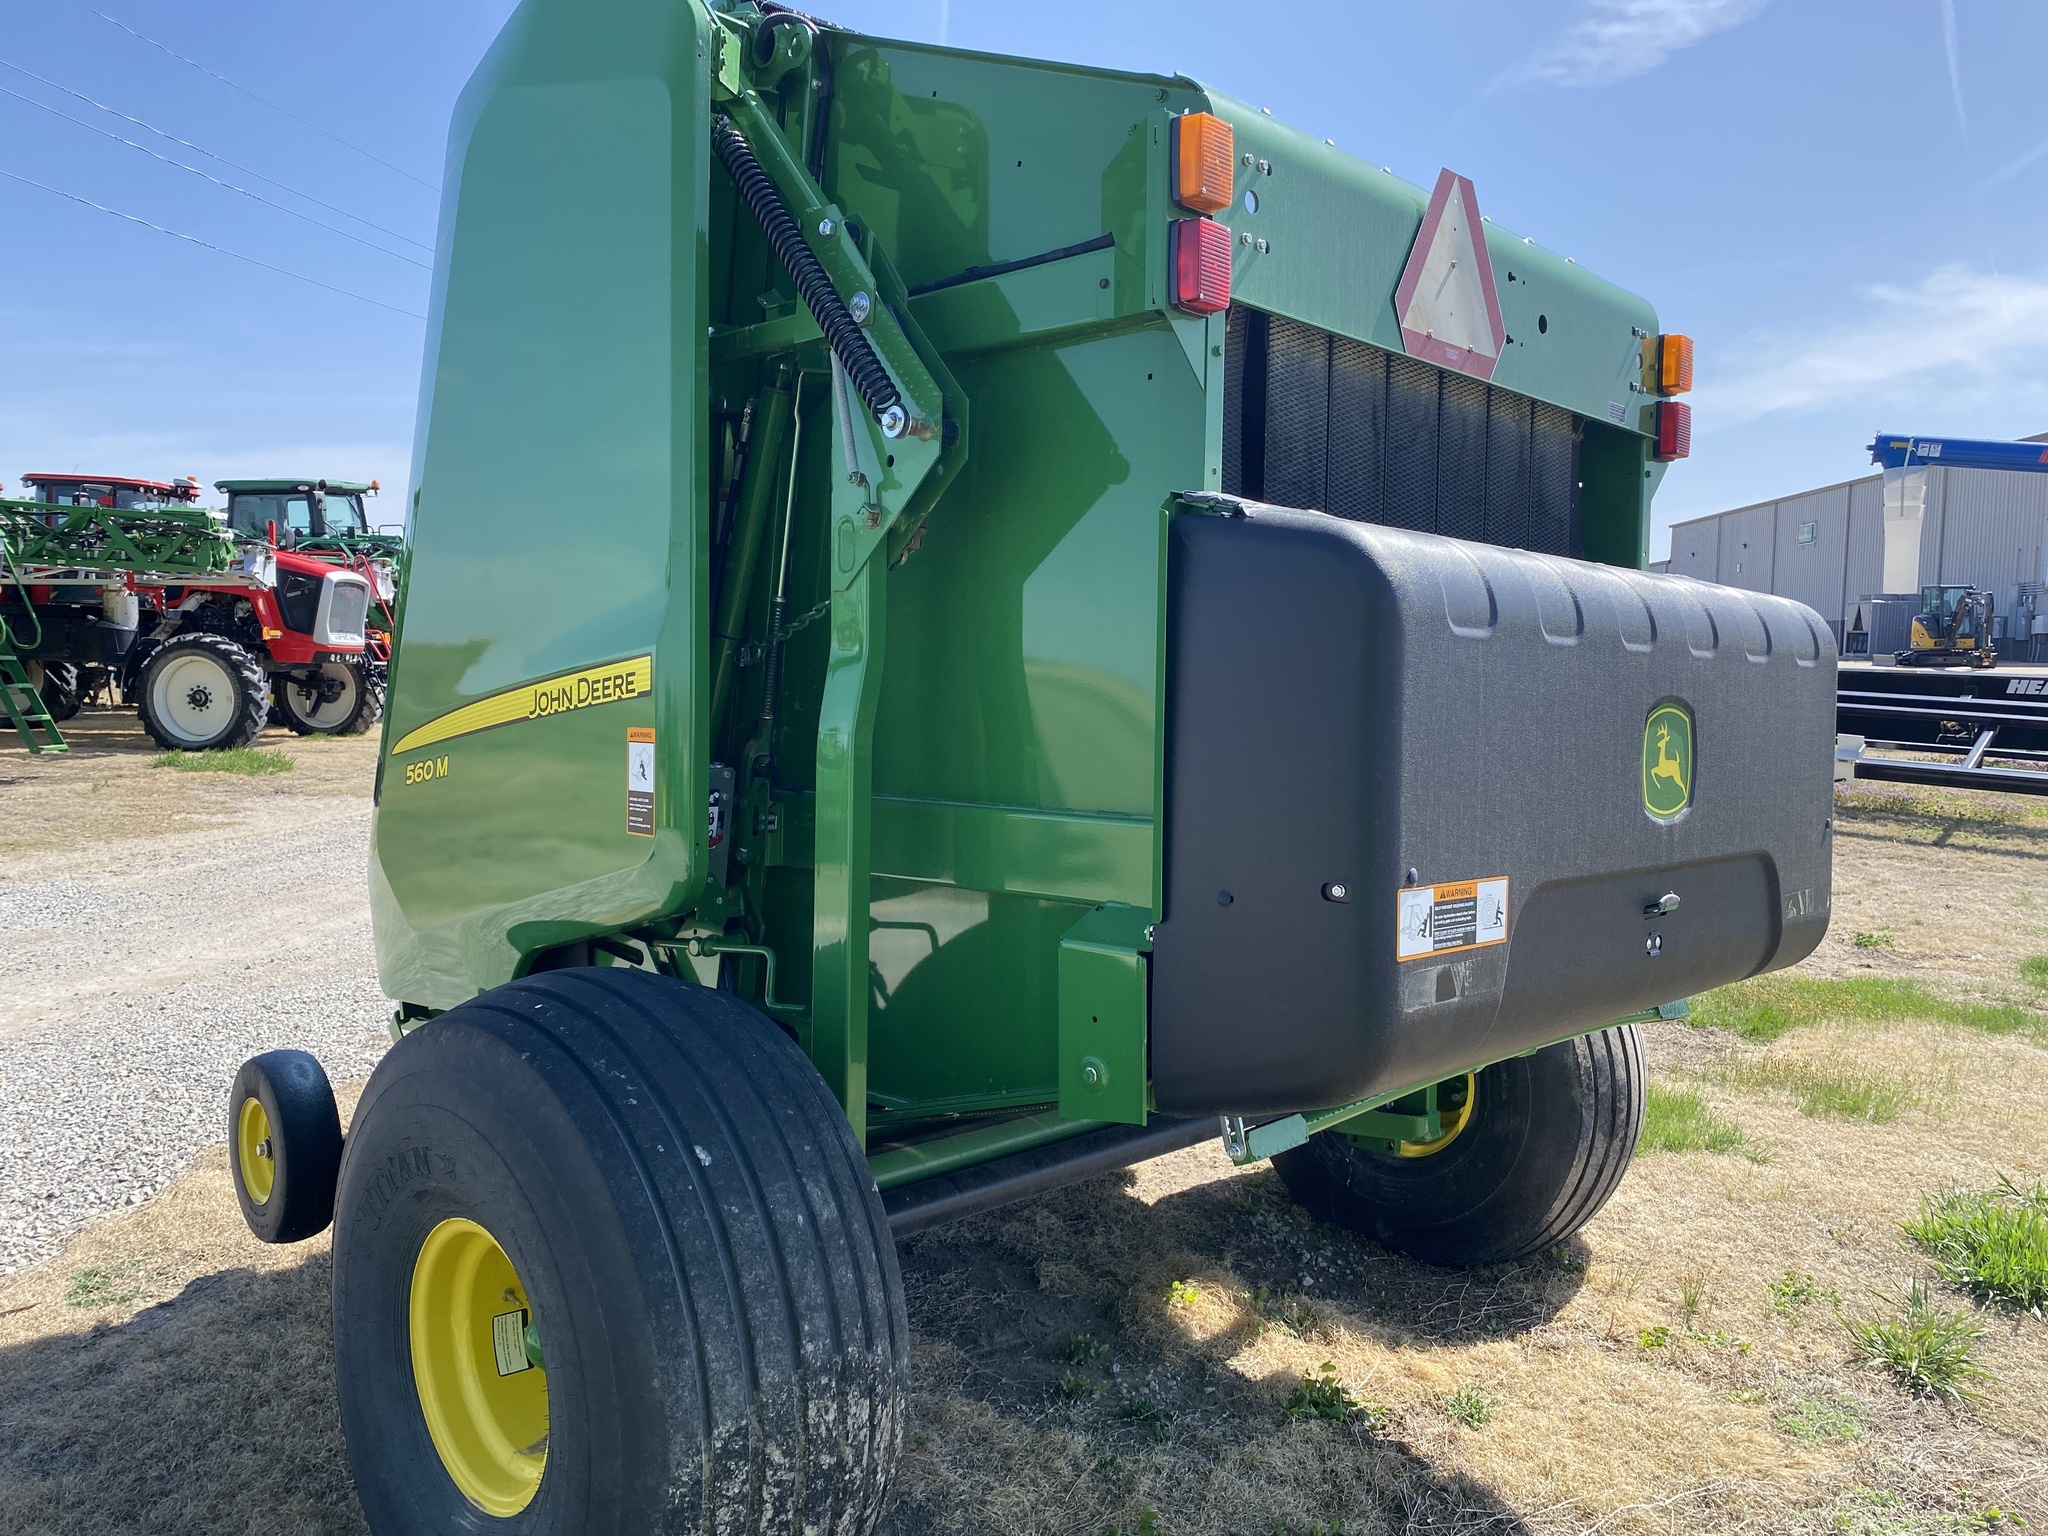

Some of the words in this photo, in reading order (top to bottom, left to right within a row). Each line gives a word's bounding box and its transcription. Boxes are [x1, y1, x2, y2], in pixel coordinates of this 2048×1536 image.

[529, 686, 573, 715] JOHN
[577, 671, 636, 704] DEERE
[405, 759, 434, 786] 560
[436, 754, 449, 779] M
[1445, 887, 1472, 898] WARNING
[357, 1146, 432, 1232] TITAN
